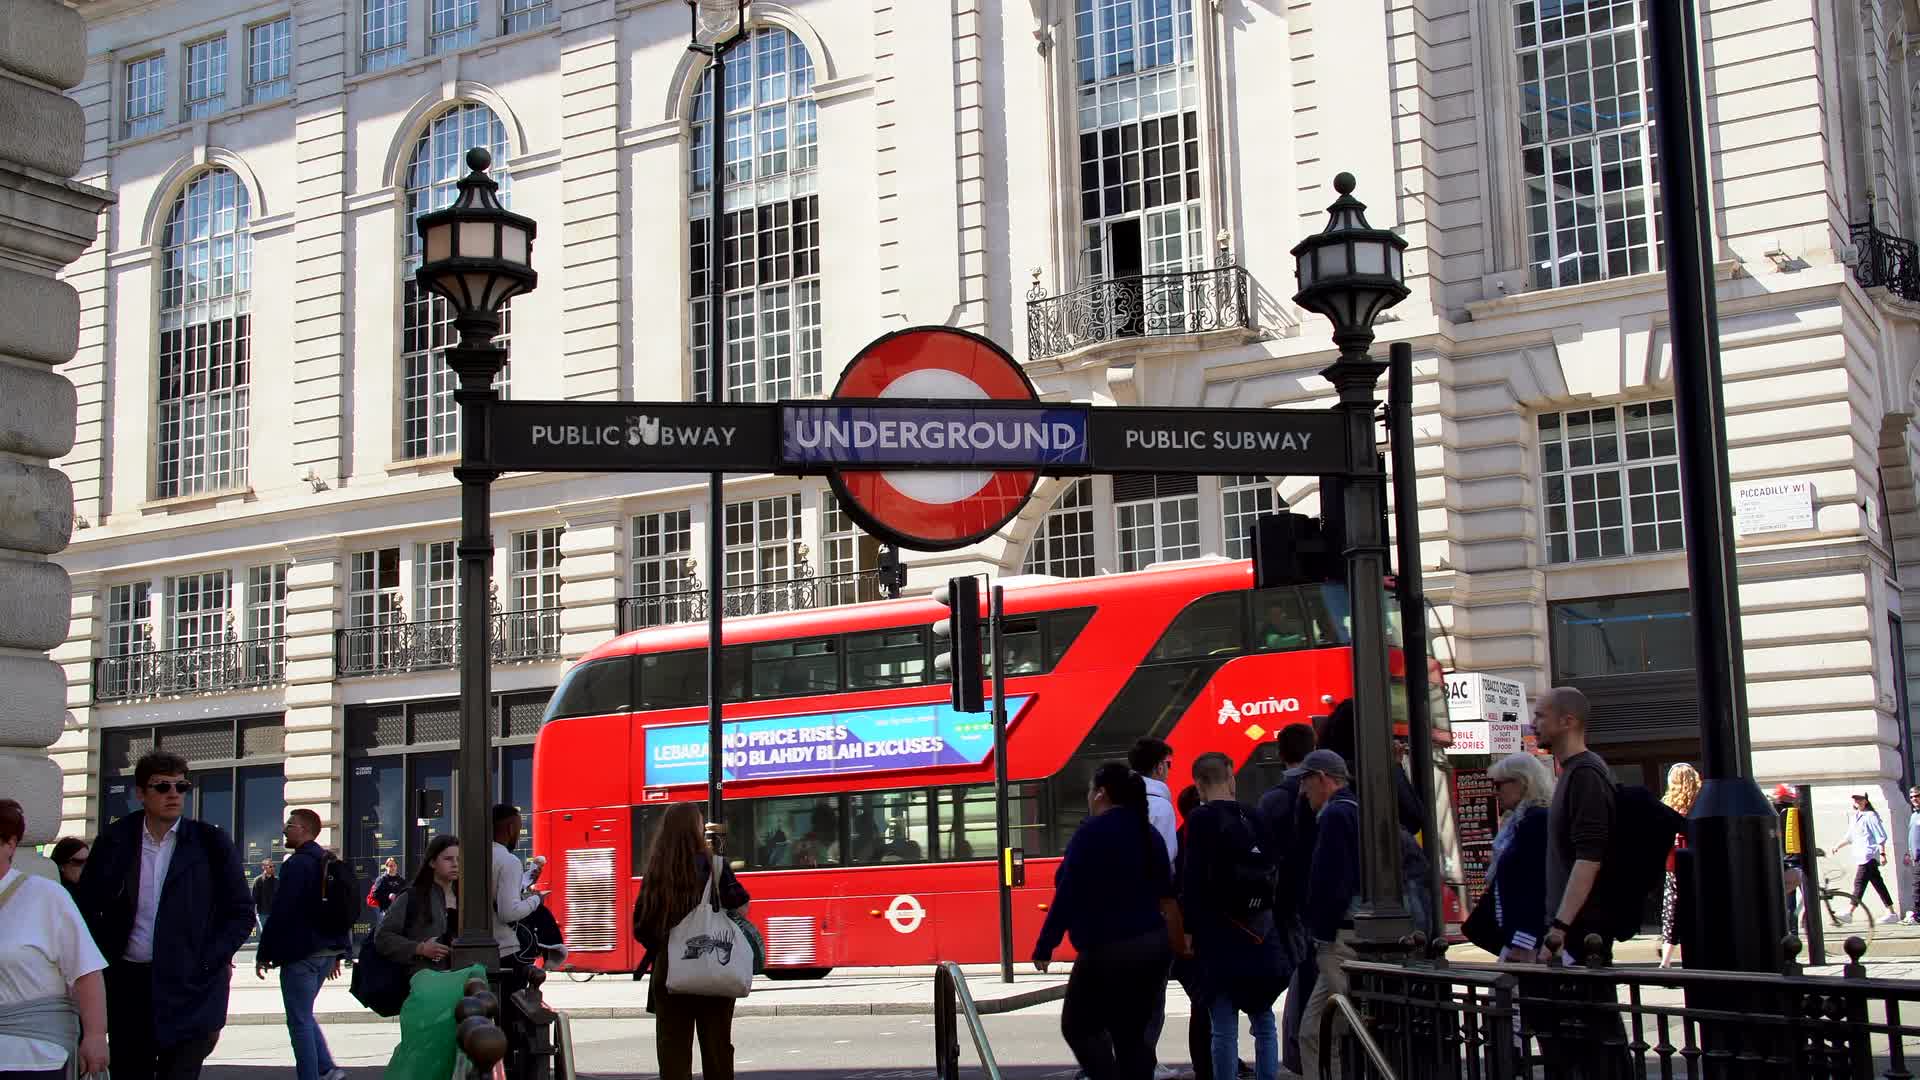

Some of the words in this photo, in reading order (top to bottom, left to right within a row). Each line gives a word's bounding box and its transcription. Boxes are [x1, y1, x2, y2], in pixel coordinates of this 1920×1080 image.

[531, 425, 620, 445] PUBLIC
[627, 425, 737, 446] SBWAY
[796, 420, 1076, 449] UNDERGROUND
[1125, 430, 1206, 449] PUBLIC
[1212, 431, 1312, 450] SUBWAY
[1740, 485, 1789, 498] PICCADILLY
[1792, 483, 1805, 493] W1
[1241, 696, 1299, 716] arriva
[721, 733, 747, 748] NO
[748, 728, 798, 747] PRICE
[800, 725, 848, 743] RISES
[721, 750, 748, 768] NO
[749, 746, 815, 766] BLAHDY
[816, 743, 863, 761] BLAH
[864, 736, 944, 757] EXCUSES
